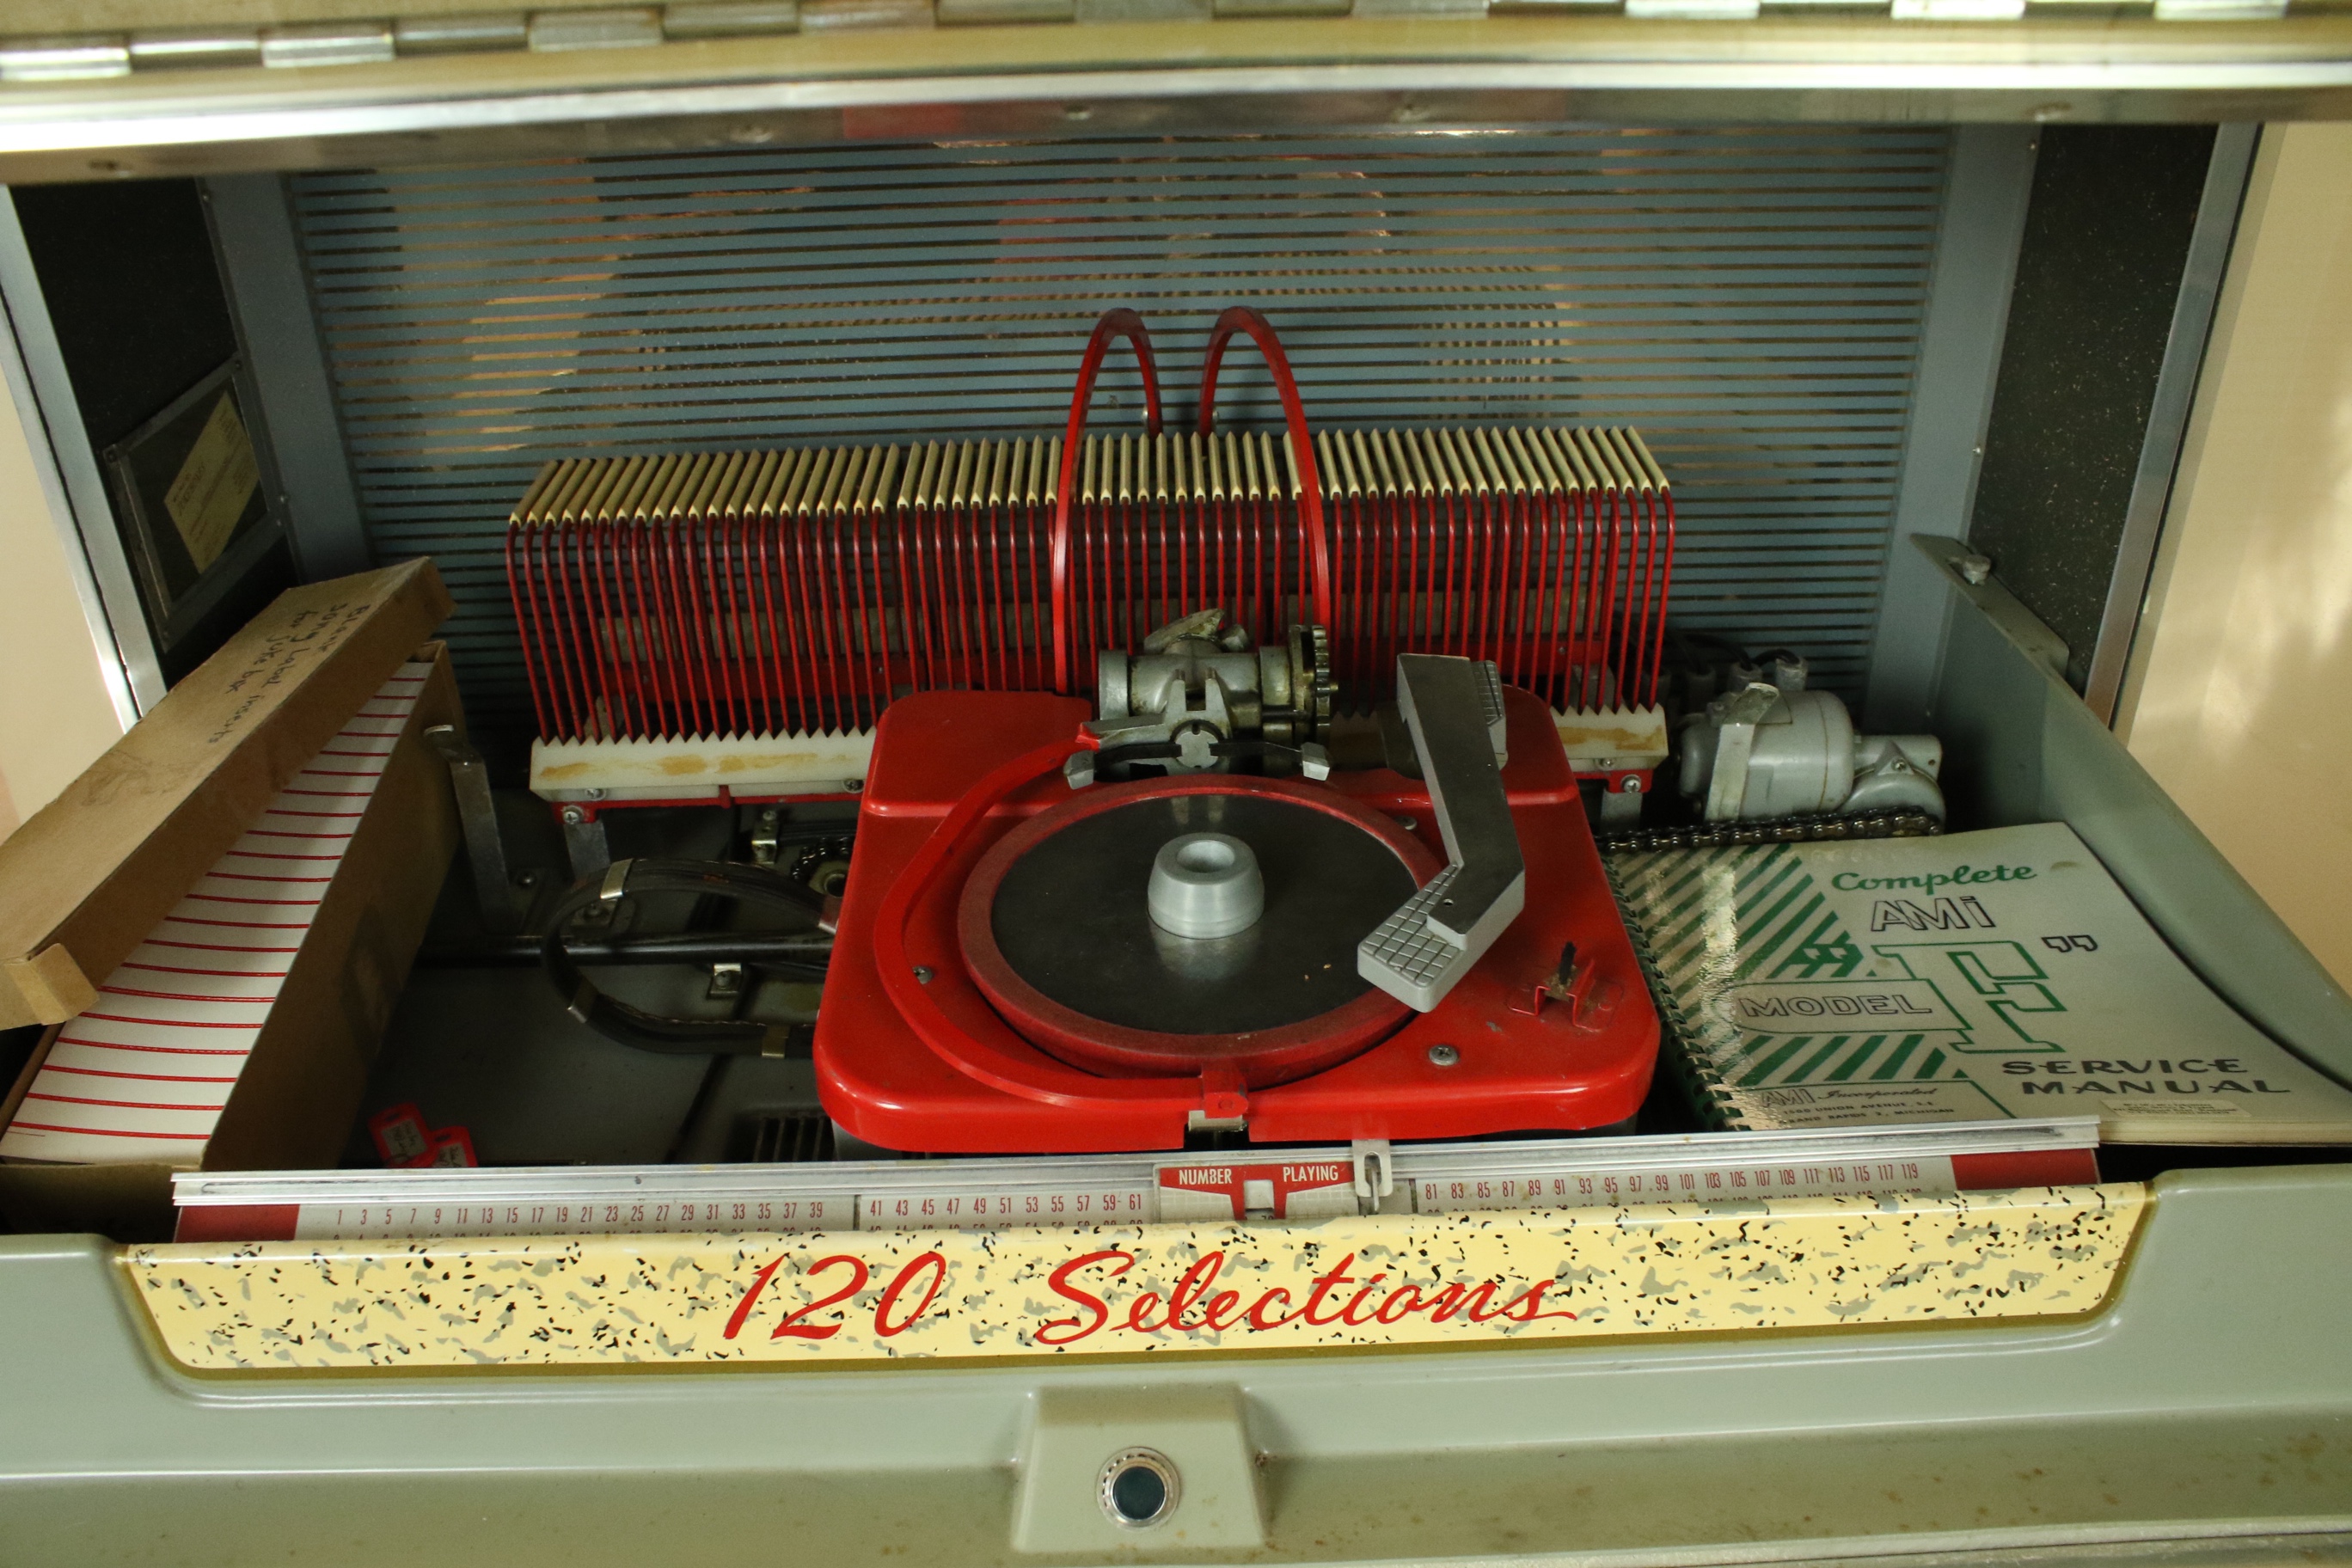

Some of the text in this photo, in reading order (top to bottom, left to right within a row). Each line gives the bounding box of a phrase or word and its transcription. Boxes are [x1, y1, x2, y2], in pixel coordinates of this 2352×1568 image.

[1831, 865, 2037, 895] Complete
[1738, 994, 1932, 1018] MODEL
[2002, 1058, 2248, 1075] SERVICE
[1817, 1087, 1938, 1099] Incorporated
[2022, 1080, 2291, 1094] MANUAL
[1179, 1165, 1339, 1185] NUMBER PLAYING
[1424, 1162, 1919, 1200] 81 83 85 87 89 91 93 95 97 99 101 103 105 107 109 111 113 115 117 119
[337, 1201, 824, 1225] 1 3 5 7 9 11 13 15 17 19 21 23 25 27 29 31 33 35 37 39
[870, 1192, 1142, 1217] 41 43 45 47 49 51 53 55 57 59 61
[724, 1250, 1577, 1344] 120 Selections
